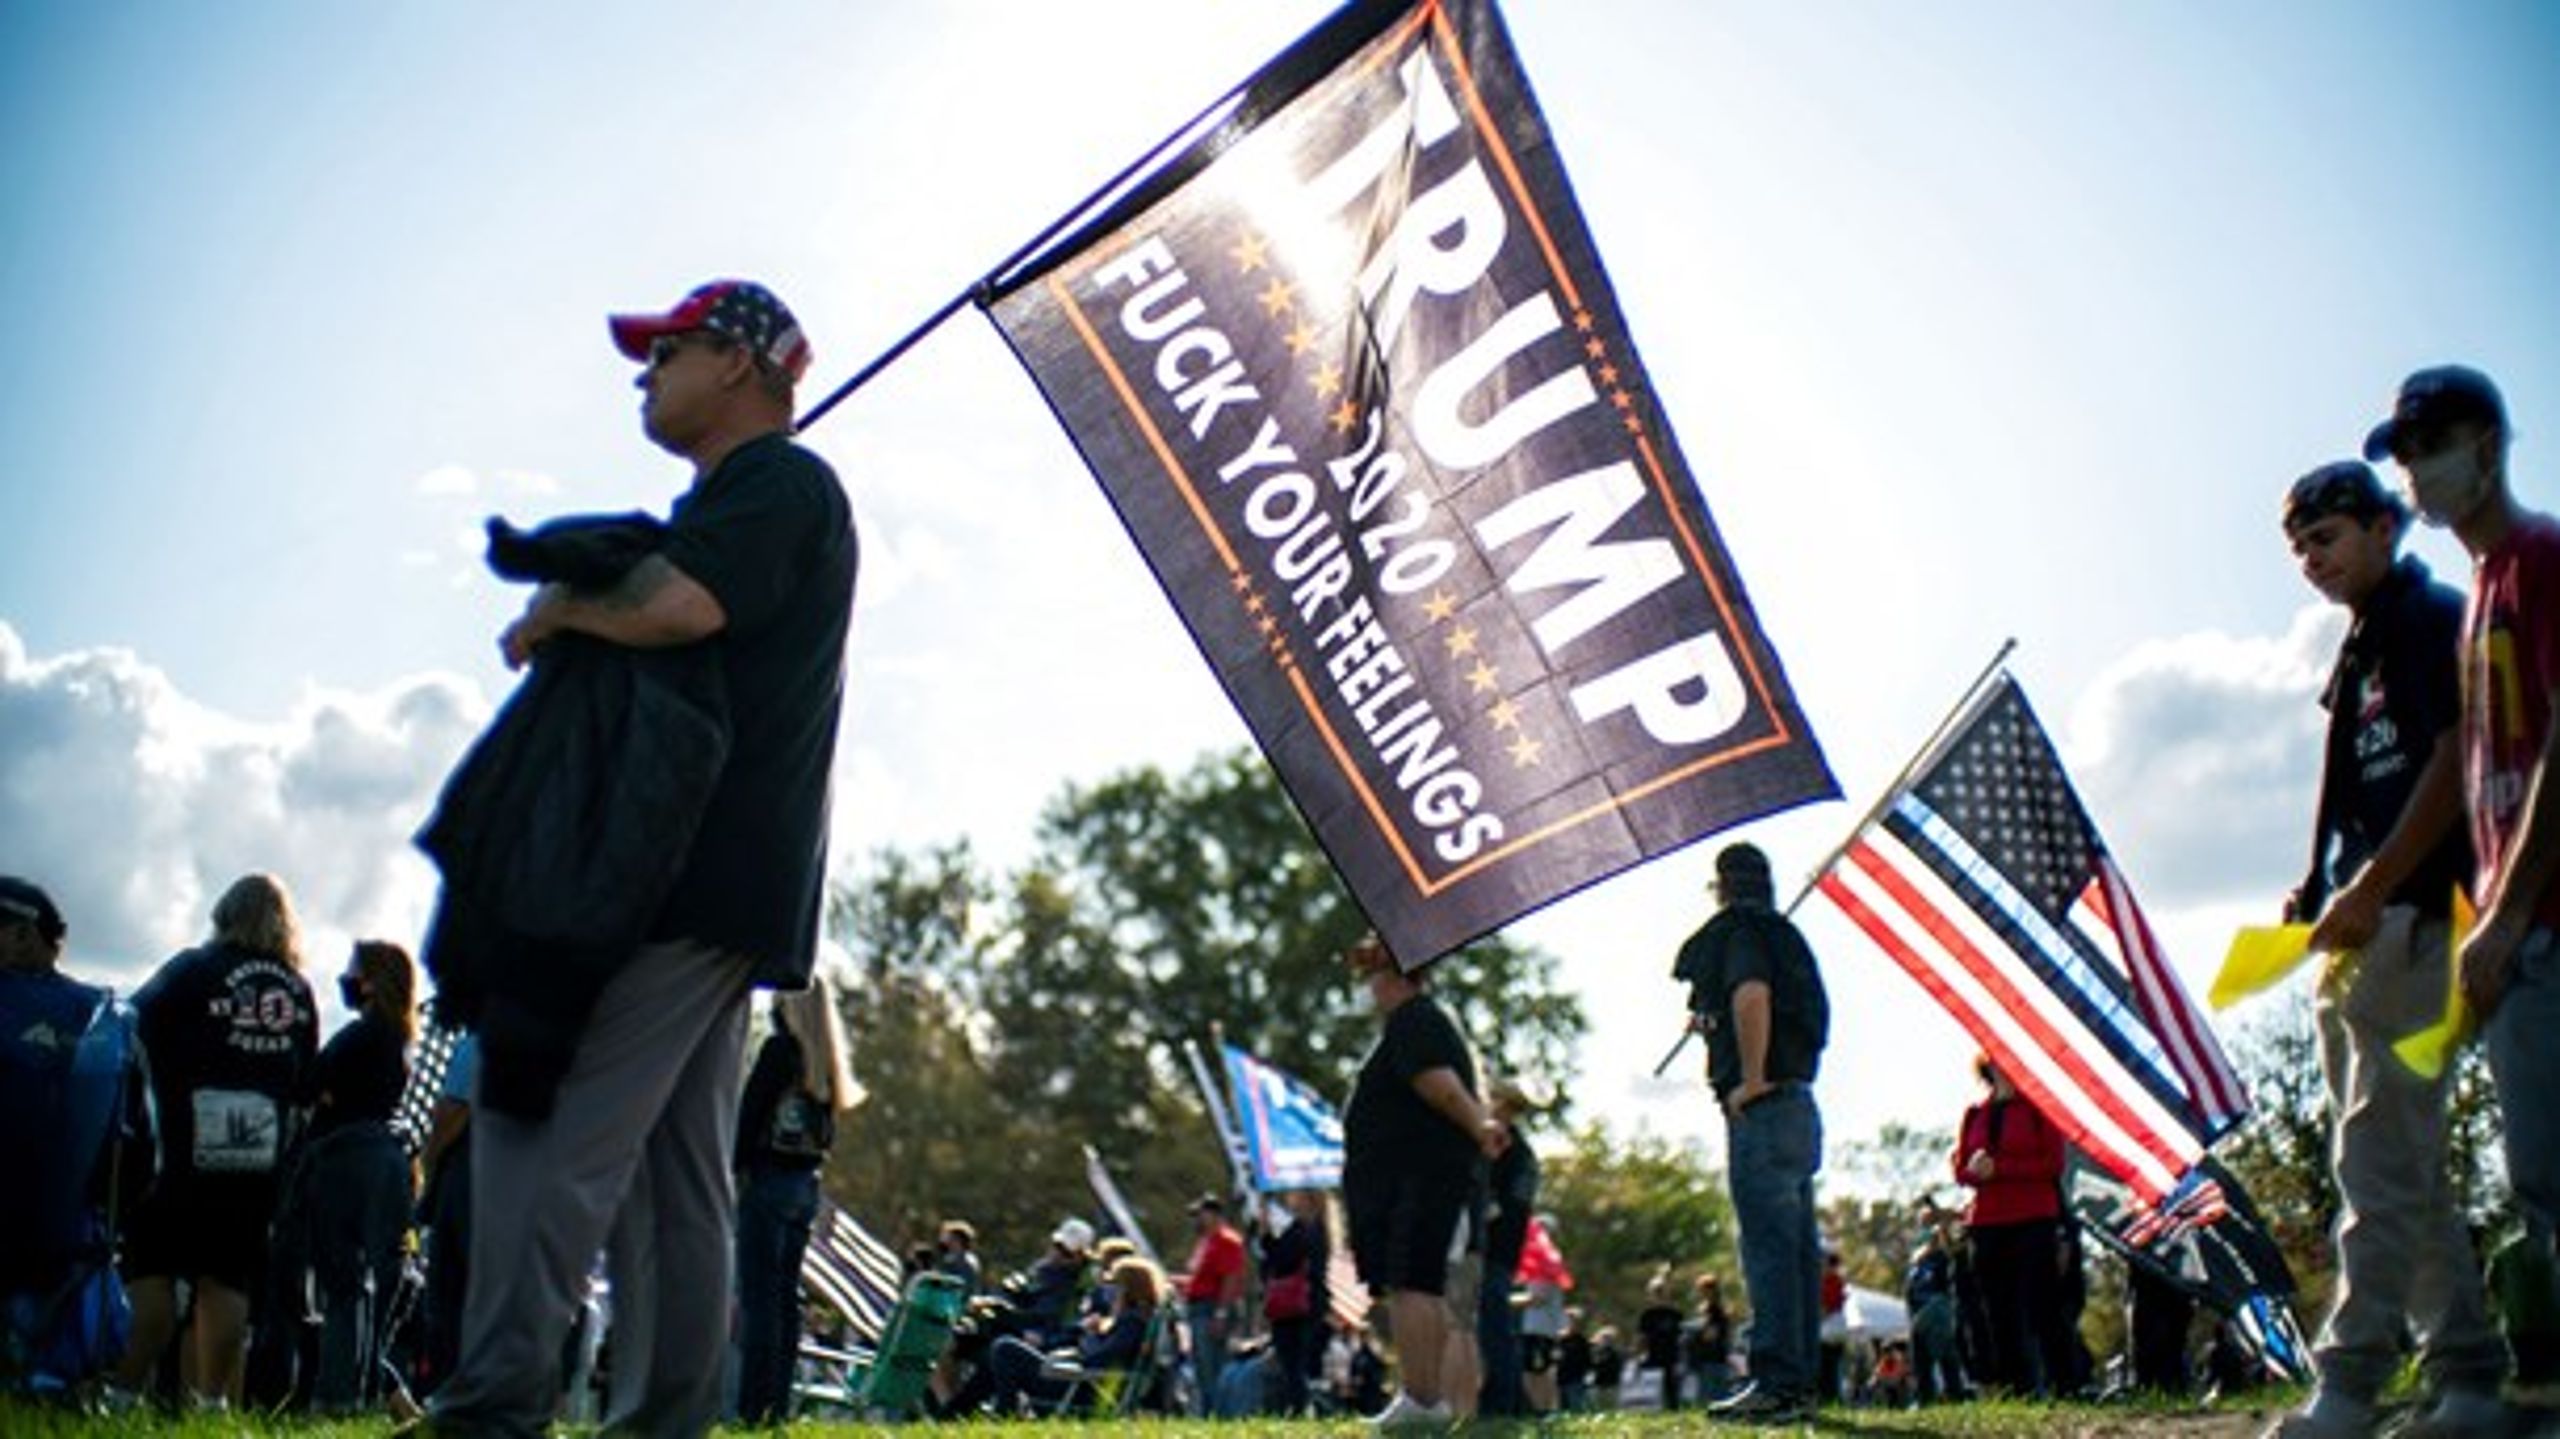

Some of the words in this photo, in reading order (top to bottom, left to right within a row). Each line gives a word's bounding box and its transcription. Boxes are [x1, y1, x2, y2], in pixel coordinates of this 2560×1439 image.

[1092, 236, 1260, 440] FUCK
[1216, 416, 1354, 624] YOUR
[1315, 594, 1503, 863] FEELINGS
[1310, 42, 1747, 745] TRUMP
[1326, 405, 1456, 594] 2020
